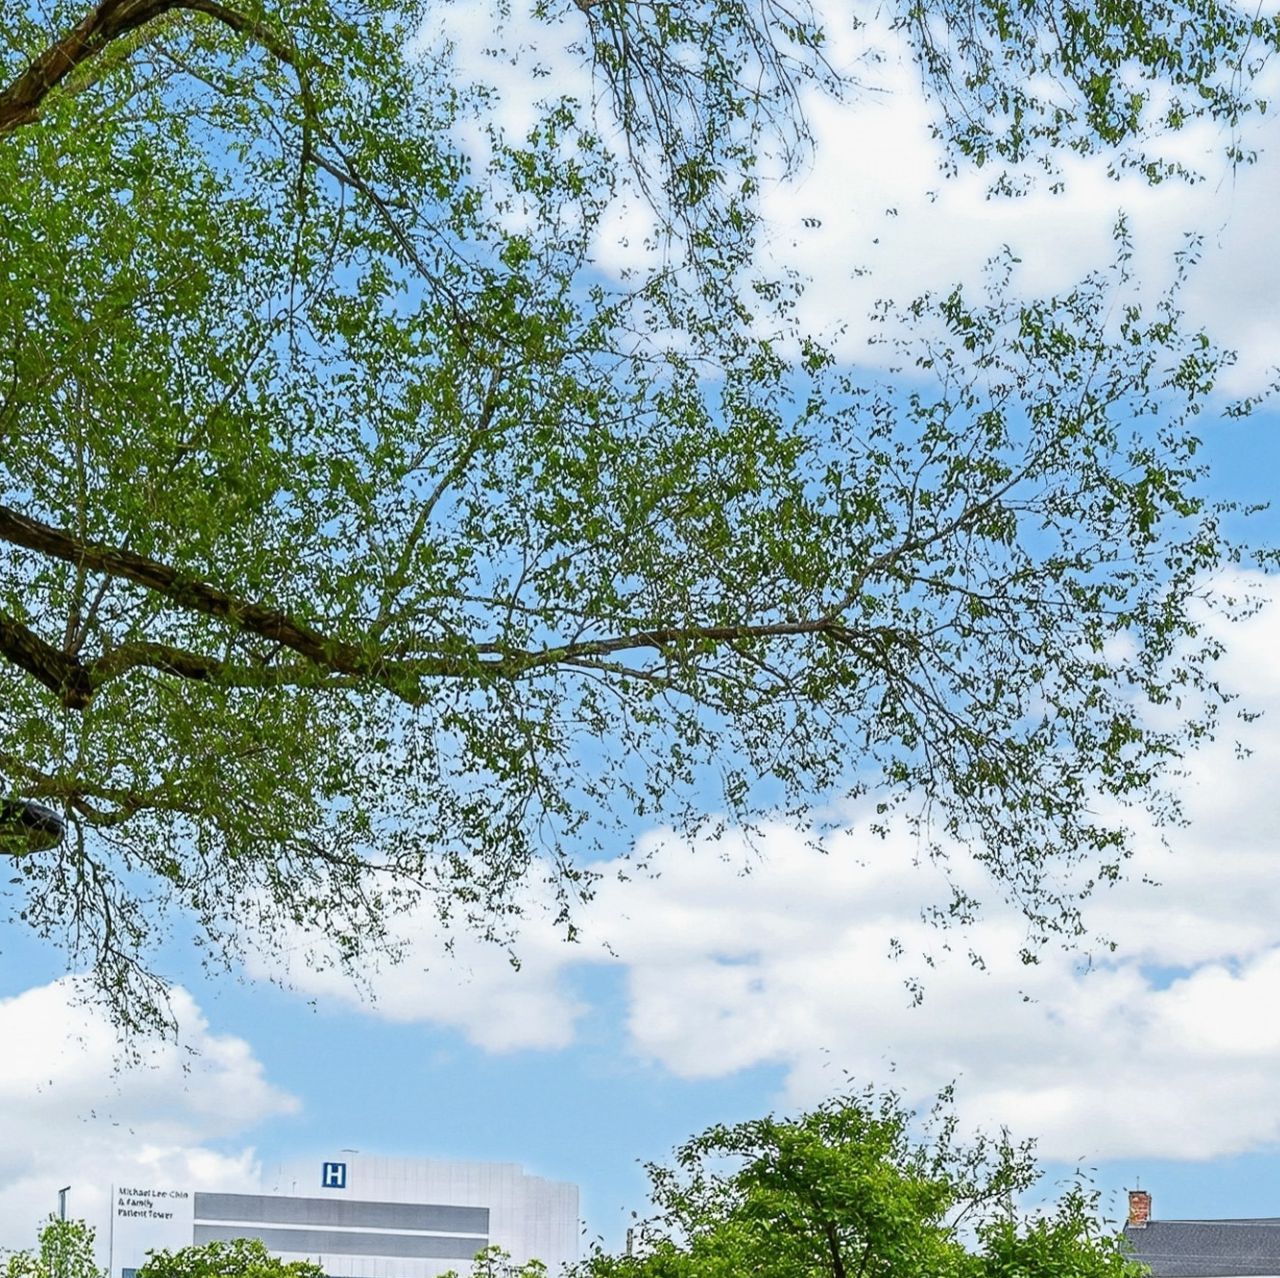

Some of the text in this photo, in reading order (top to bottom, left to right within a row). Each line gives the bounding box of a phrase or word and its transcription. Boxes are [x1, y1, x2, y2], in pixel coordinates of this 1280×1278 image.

[326, 1164, 343, 1185] H
[119, 1187, 151, 1197] Michael
[126, 1199, 153, 1208] Family
[118, 1209, 173, 1220] Patient Tower
